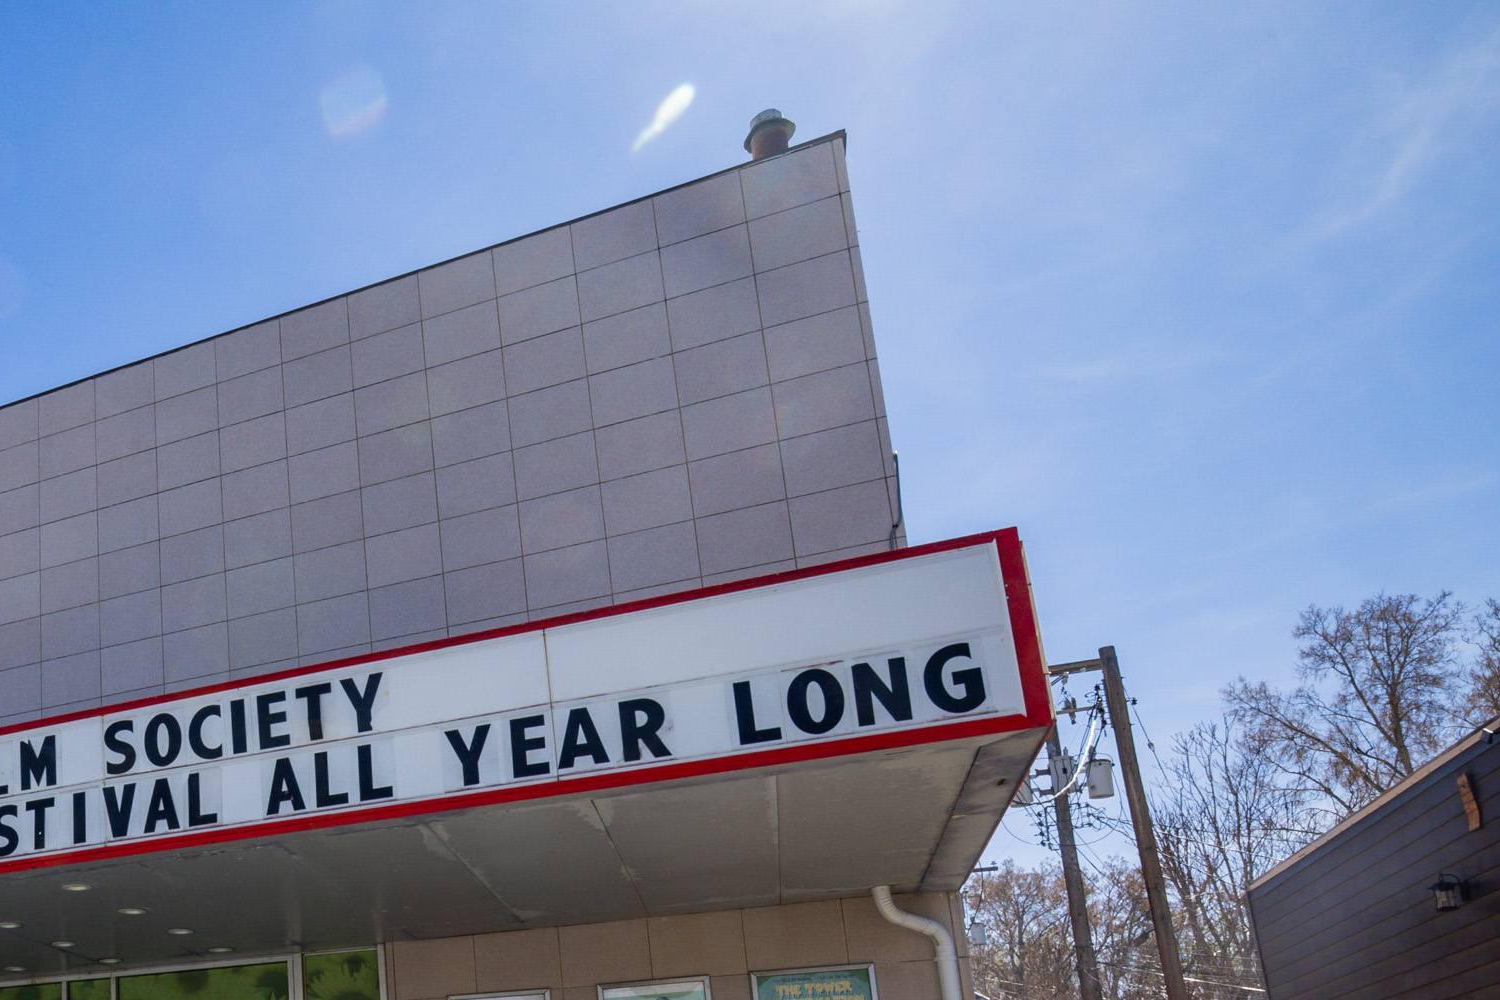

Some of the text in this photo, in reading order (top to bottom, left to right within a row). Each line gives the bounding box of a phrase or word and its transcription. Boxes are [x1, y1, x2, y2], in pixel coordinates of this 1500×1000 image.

[104, 672, 382, 774] SOCIETY
[267, 744, 393, 815] ALL
[445, 699, 672, 786] YEAR
[733, 643, 986, 745] LONG
[775, 980, 852, 1000] THE TOWER
